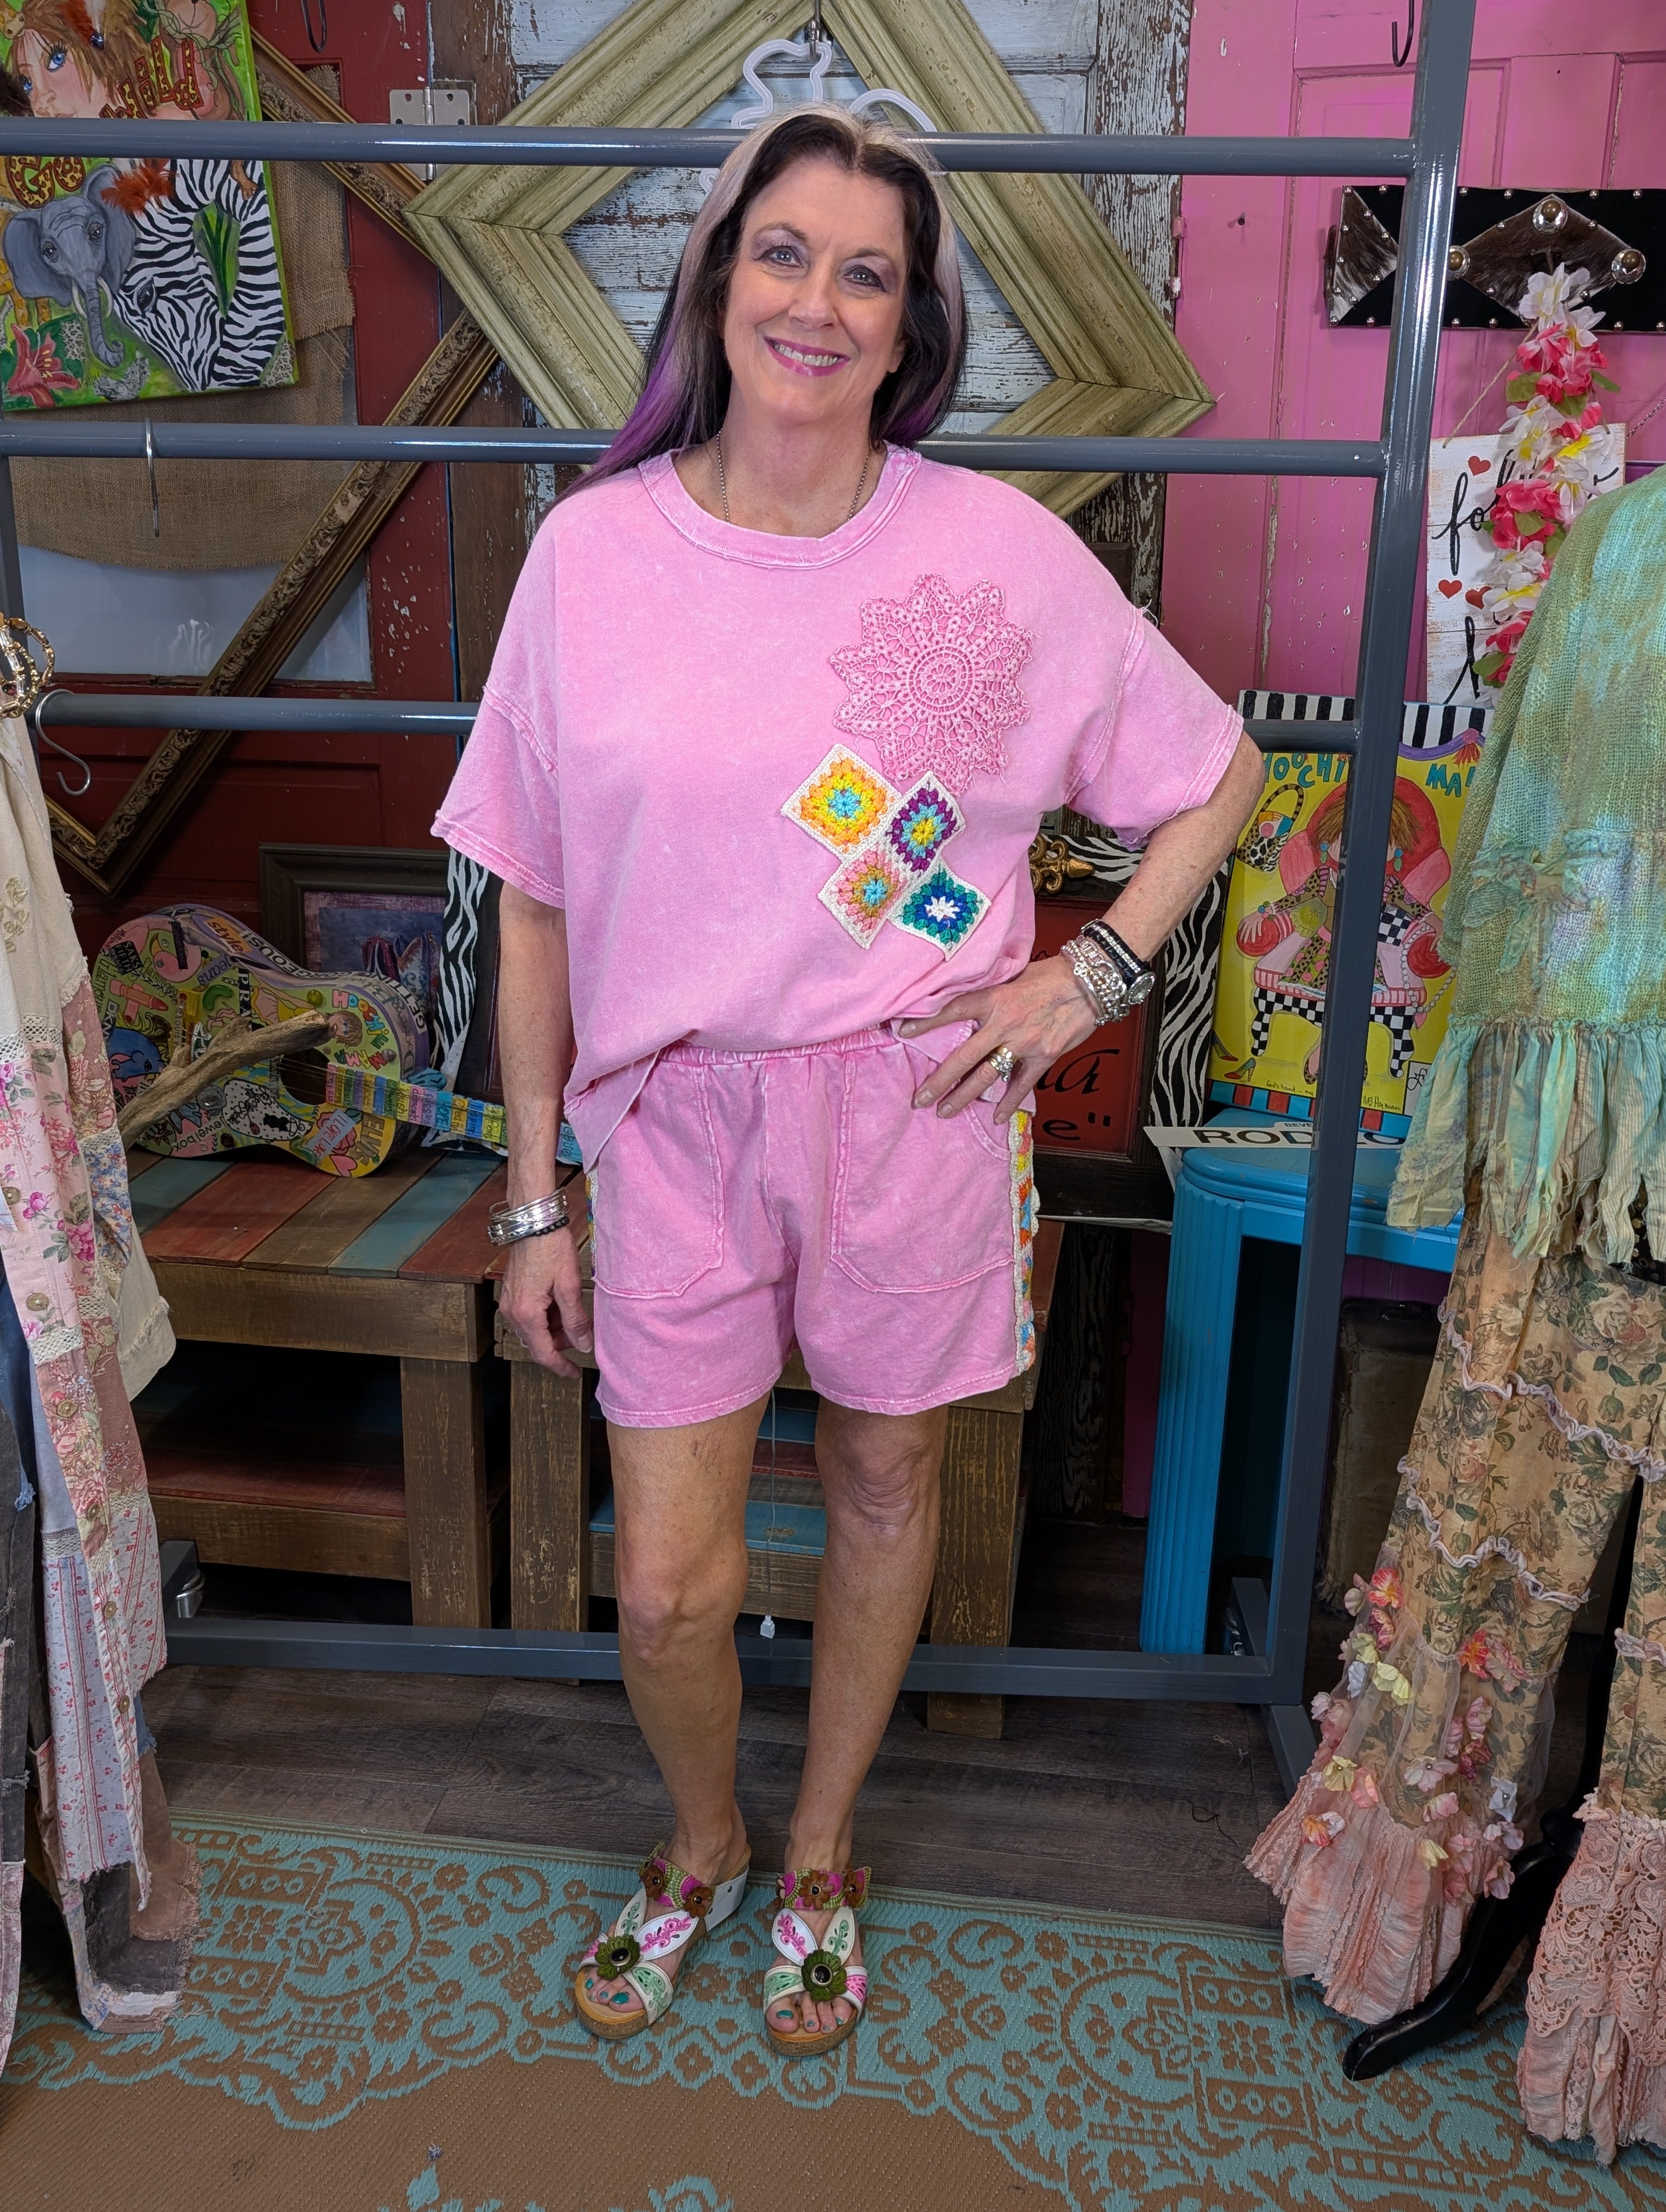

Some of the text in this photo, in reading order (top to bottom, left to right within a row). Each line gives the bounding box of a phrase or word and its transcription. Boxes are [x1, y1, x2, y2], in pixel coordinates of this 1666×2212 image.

[1425, 763, 1476, 798] MA
[208, 921, 244, 952] style
[109, 949, 126, 974] AVENUE
[115, 944, 132, 973] FIFTH
[123, 941, 141, 972] SAKS
[174, 1017, 182, 1041] LOUIS
[332, 988, 390, 1050] HOOCHIE
[334, 1049, 388, 1071] MAMA
[323, 1118, 345, 1140] LOVE
[350, 1113, 385, 1166] ELVIS
[1193, 1129, 1406, 1146] RODO
